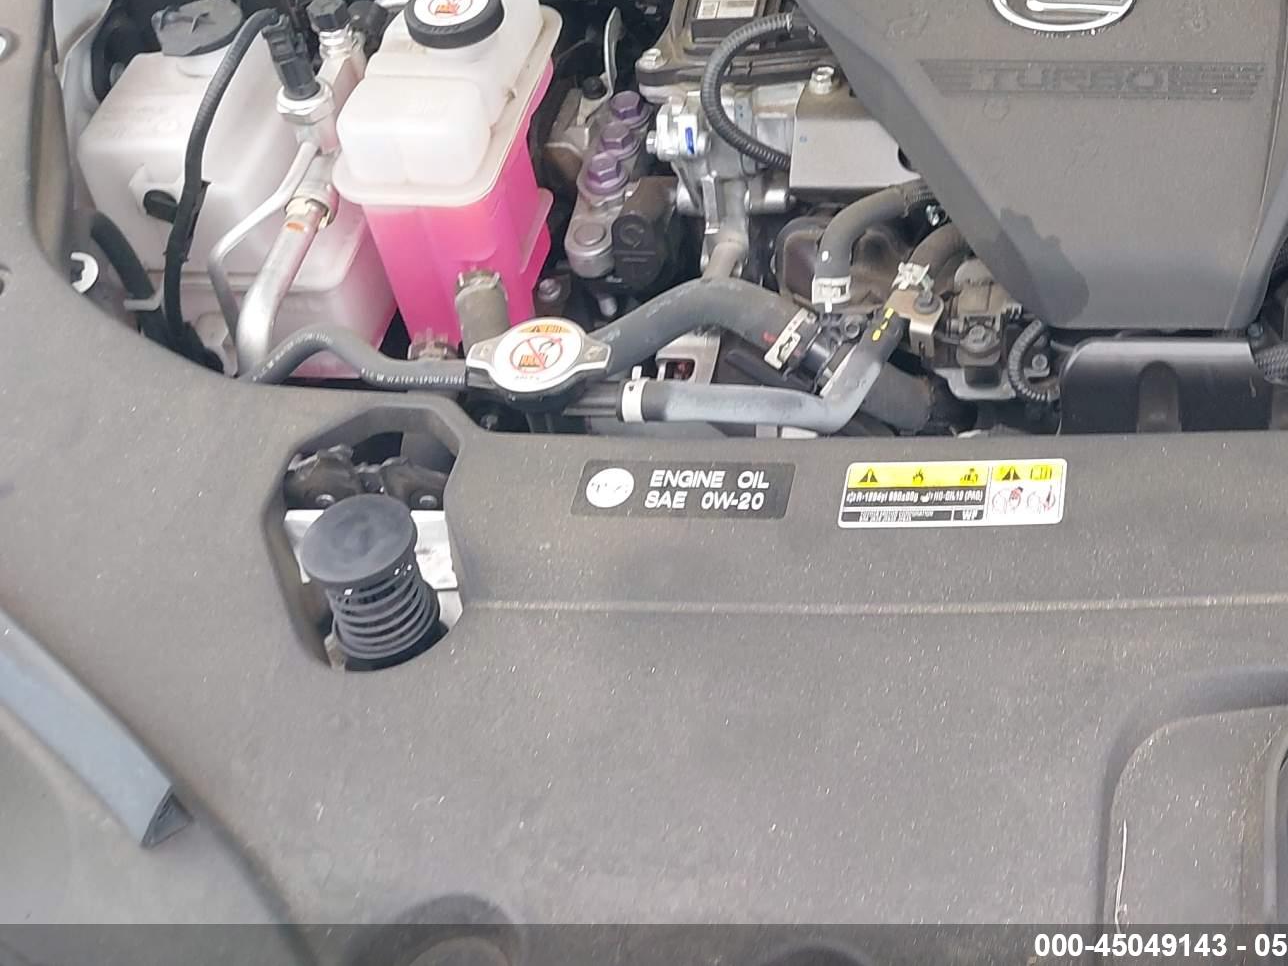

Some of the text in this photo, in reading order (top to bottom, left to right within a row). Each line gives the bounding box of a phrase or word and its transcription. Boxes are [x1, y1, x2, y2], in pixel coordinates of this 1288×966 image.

[649, 469, 726, 489] ENGINE
[737, 470, 770, 489] OIL
[644, 490, 765, 510] SAE 0W-20
